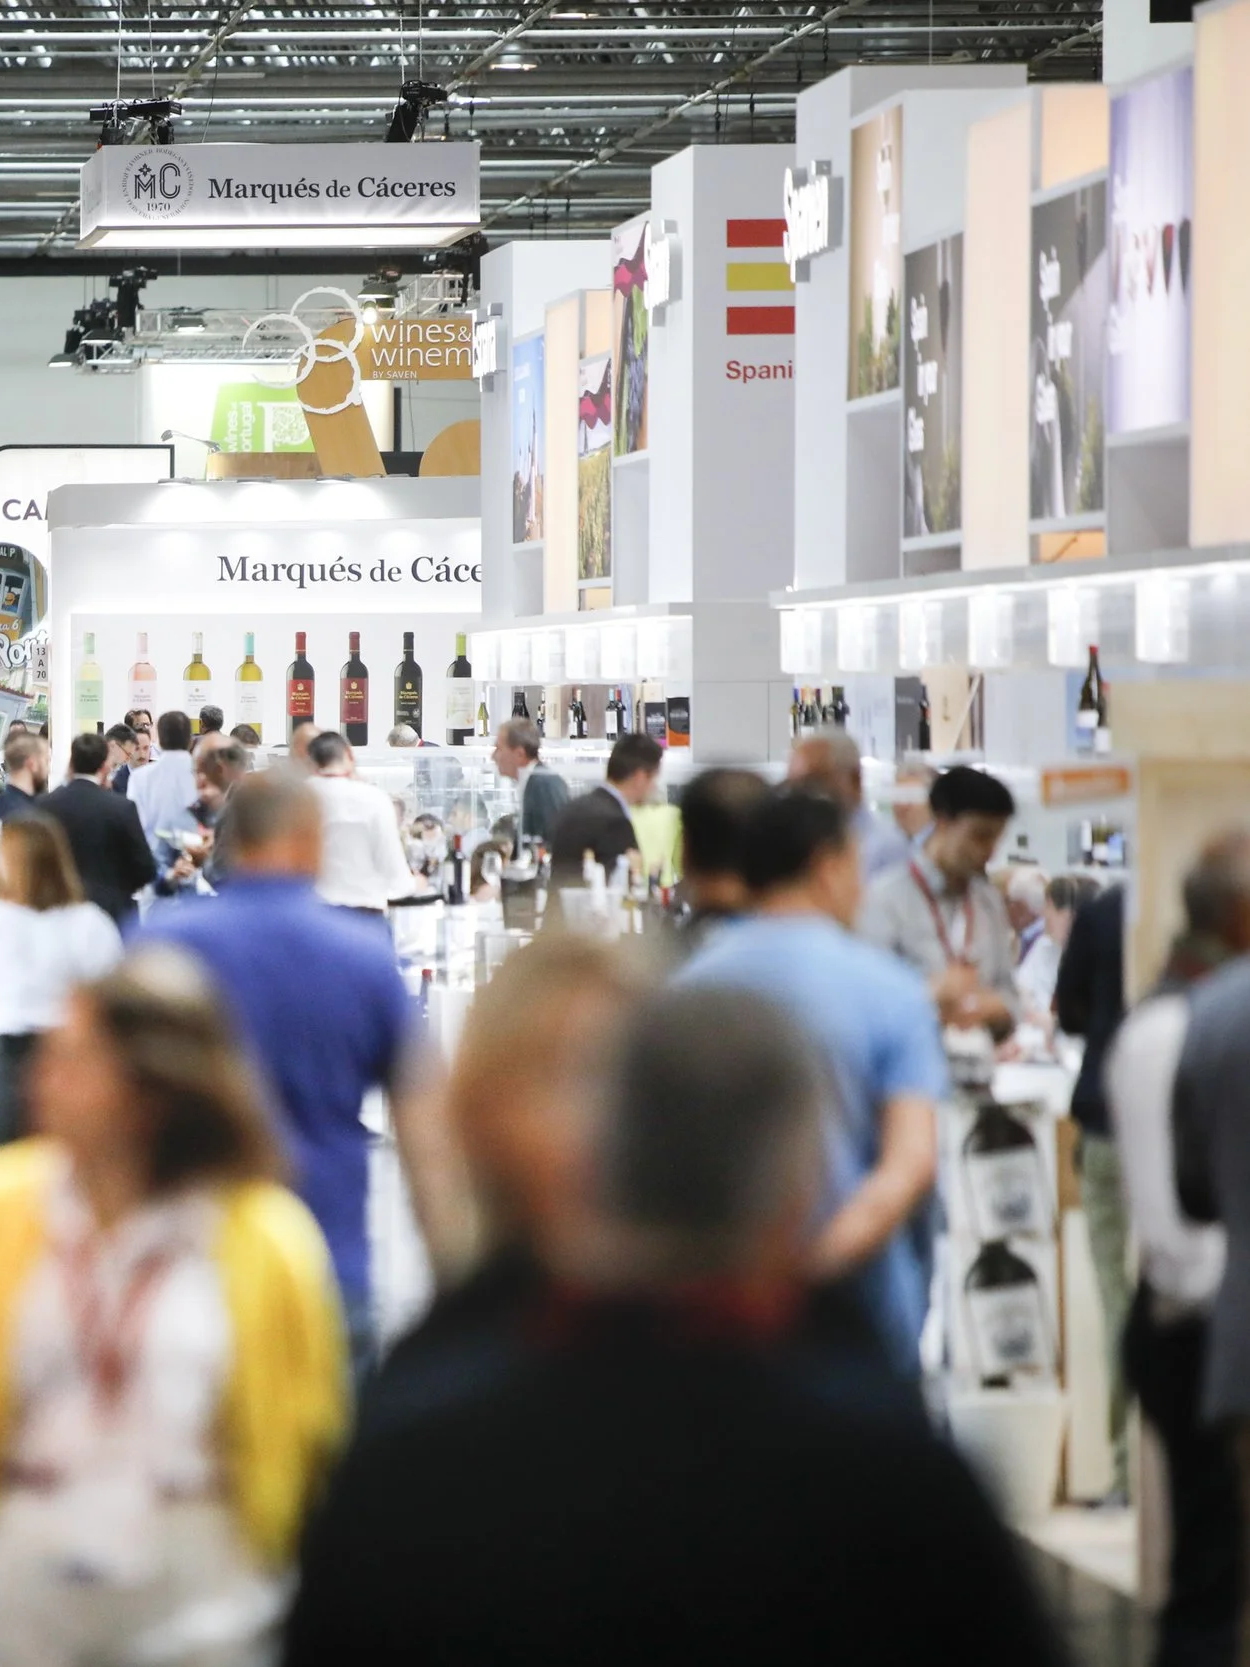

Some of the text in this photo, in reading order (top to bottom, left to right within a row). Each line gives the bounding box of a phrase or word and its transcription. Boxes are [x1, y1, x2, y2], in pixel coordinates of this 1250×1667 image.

[134, 163, 181, 199] MC
[208, 178, 320, 204] Marqués
[326, 180, 351, 198] de
[358, 177, 456, 198] Cáceres
[147, 203, 171, 212] 1970
[372, 370, 417, 379] BY SAVEN
[726, 360, 793, 384] Spani
[2, 499, 48, 521] CA
[217, 556, 362, 589] Marqués
[370, 560, 402, 583] de
[12, 619, 19, 630] 6
[36, 648, 46, 656] 13
[38, 659, 44, 667] A
[36, 670, 46, 679] 70
